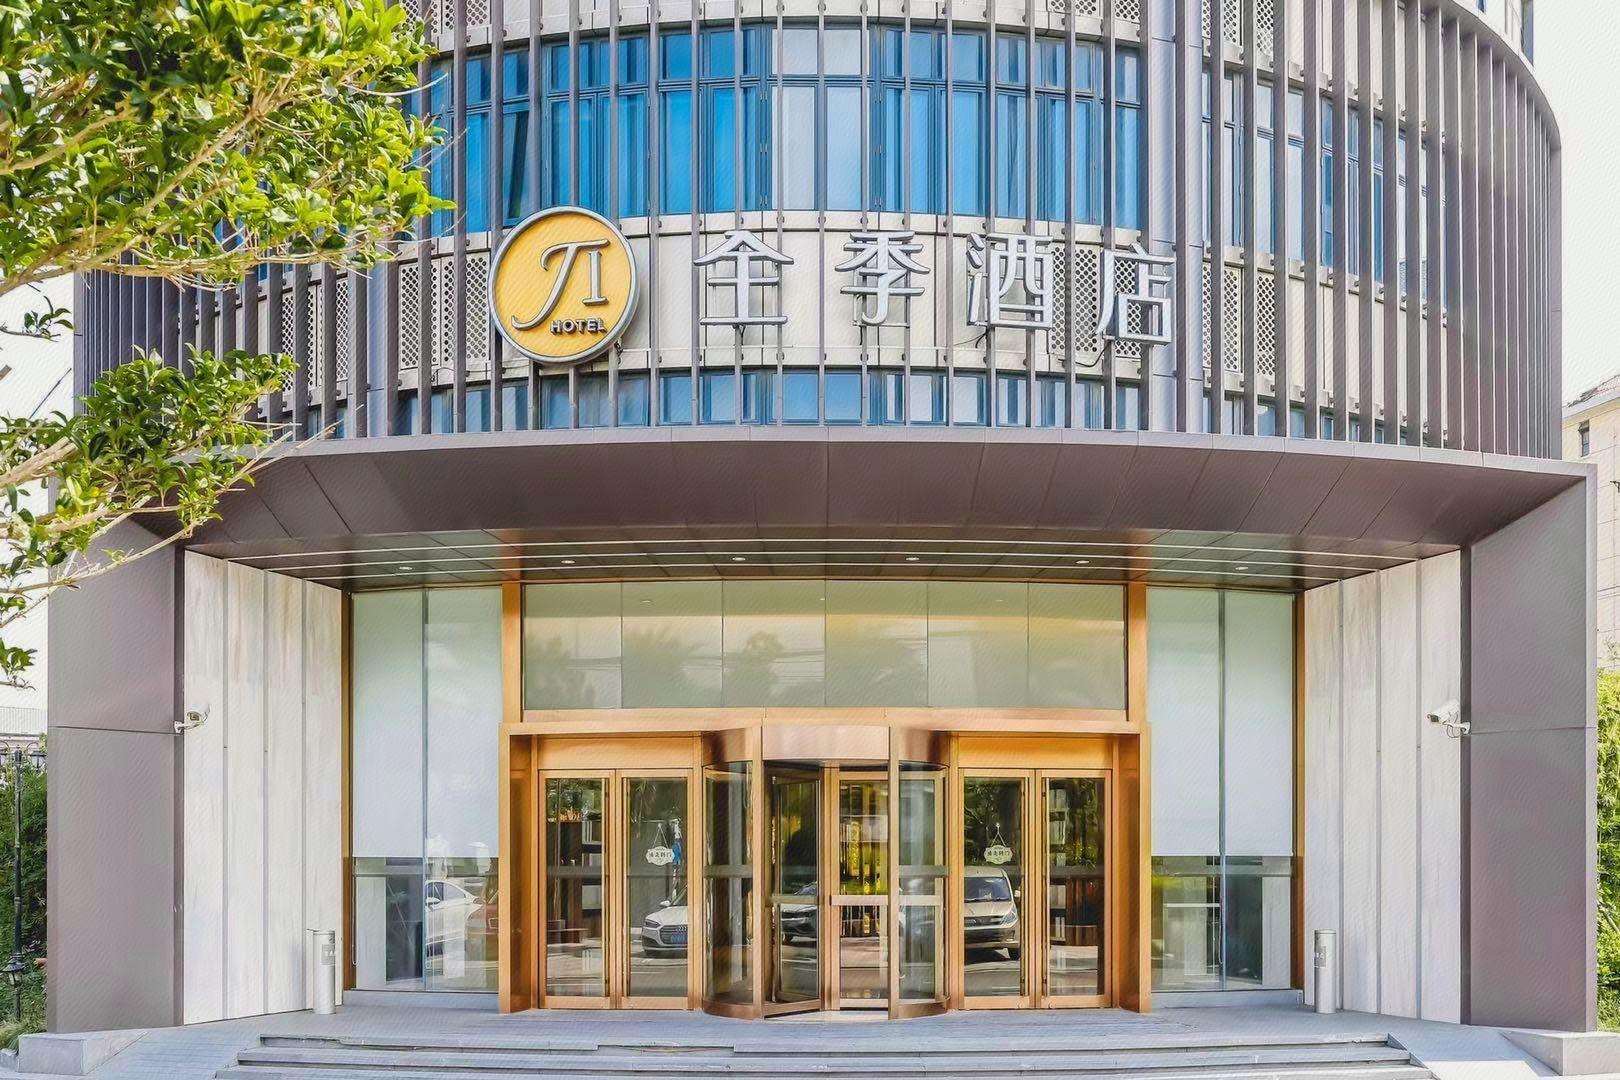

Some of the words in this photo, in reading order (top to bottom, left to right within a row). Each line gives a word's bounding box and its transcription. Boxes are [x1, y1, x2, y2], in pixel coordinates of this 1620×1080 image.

[693, 230, 1175, 345] 全季酒店
[550, 317, 607, 335] HOTEL
